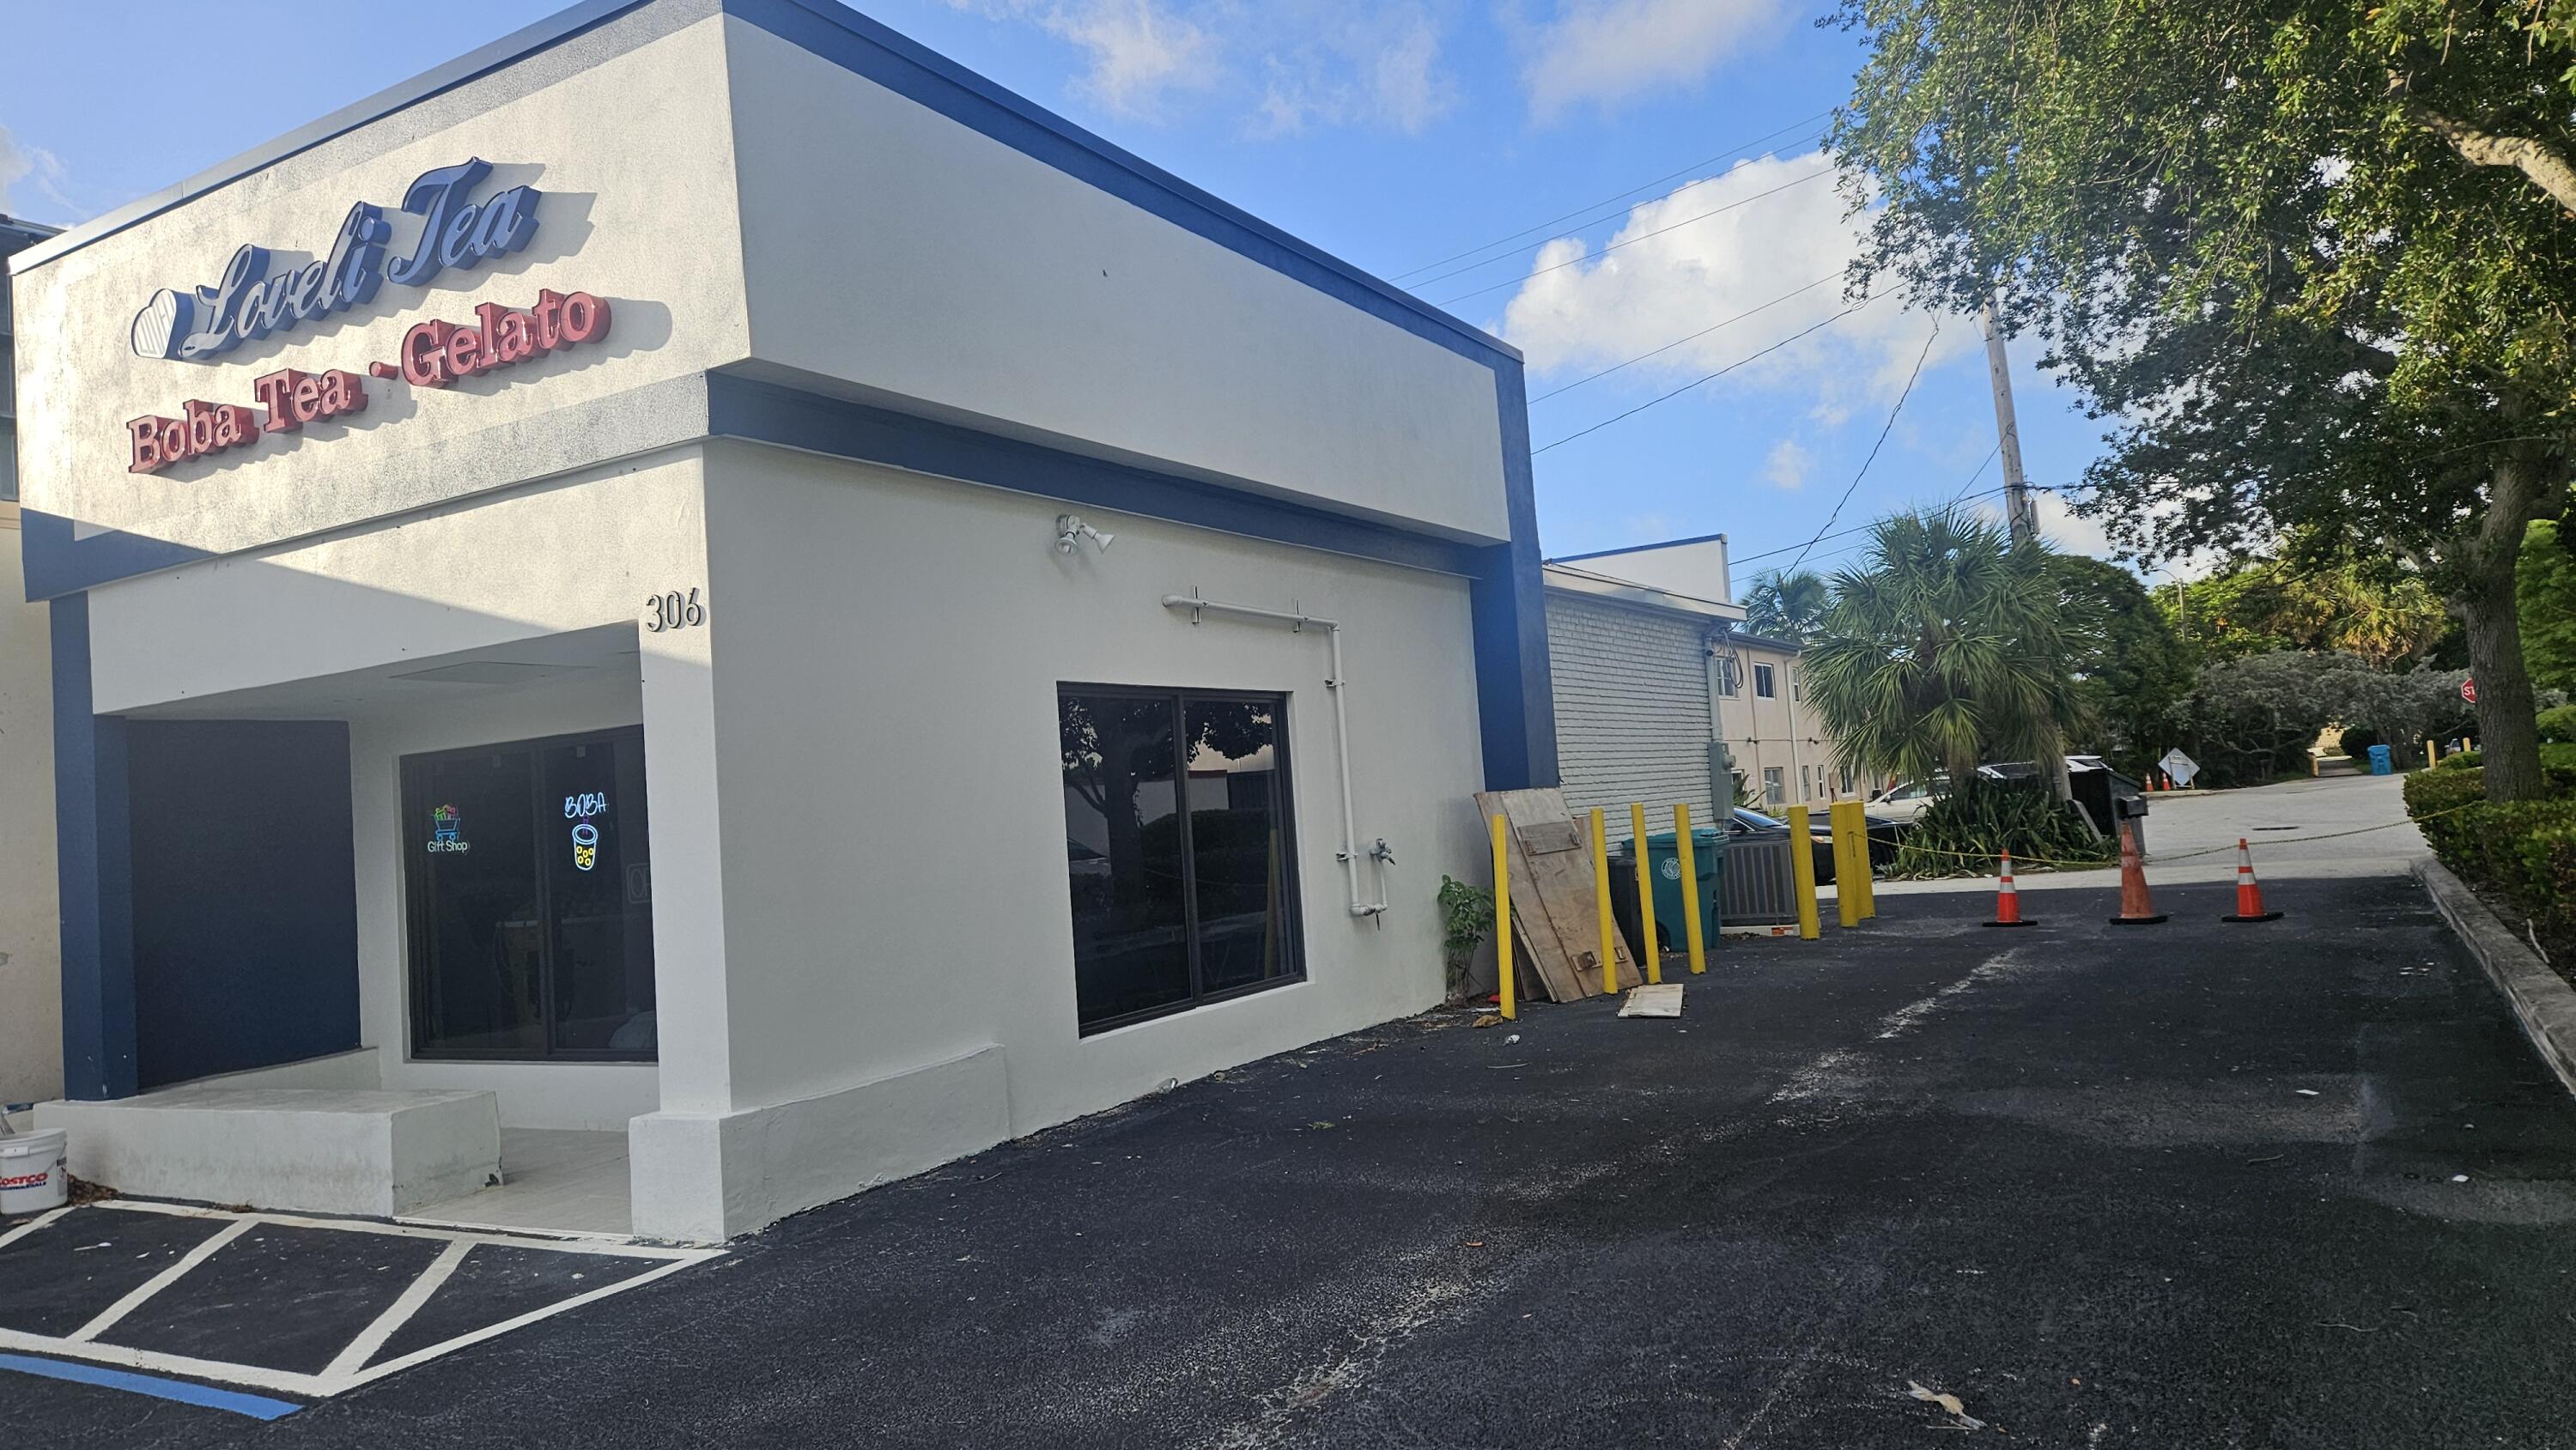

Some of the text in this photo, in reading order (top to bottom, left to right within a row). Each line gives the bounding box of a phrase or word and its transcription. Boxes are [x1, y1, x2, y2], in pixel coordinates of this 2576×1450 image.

[179, 156, 531, 359] Loveli Tea
[126, 288, 603, 473] Boba Tea Gelato
[646, 587, 702, 634] 306
[2464, 686, 2475, 695] ST
[564, 792, 607, 818] BOBA
[428, 840, 468, 853] Gift Shop
